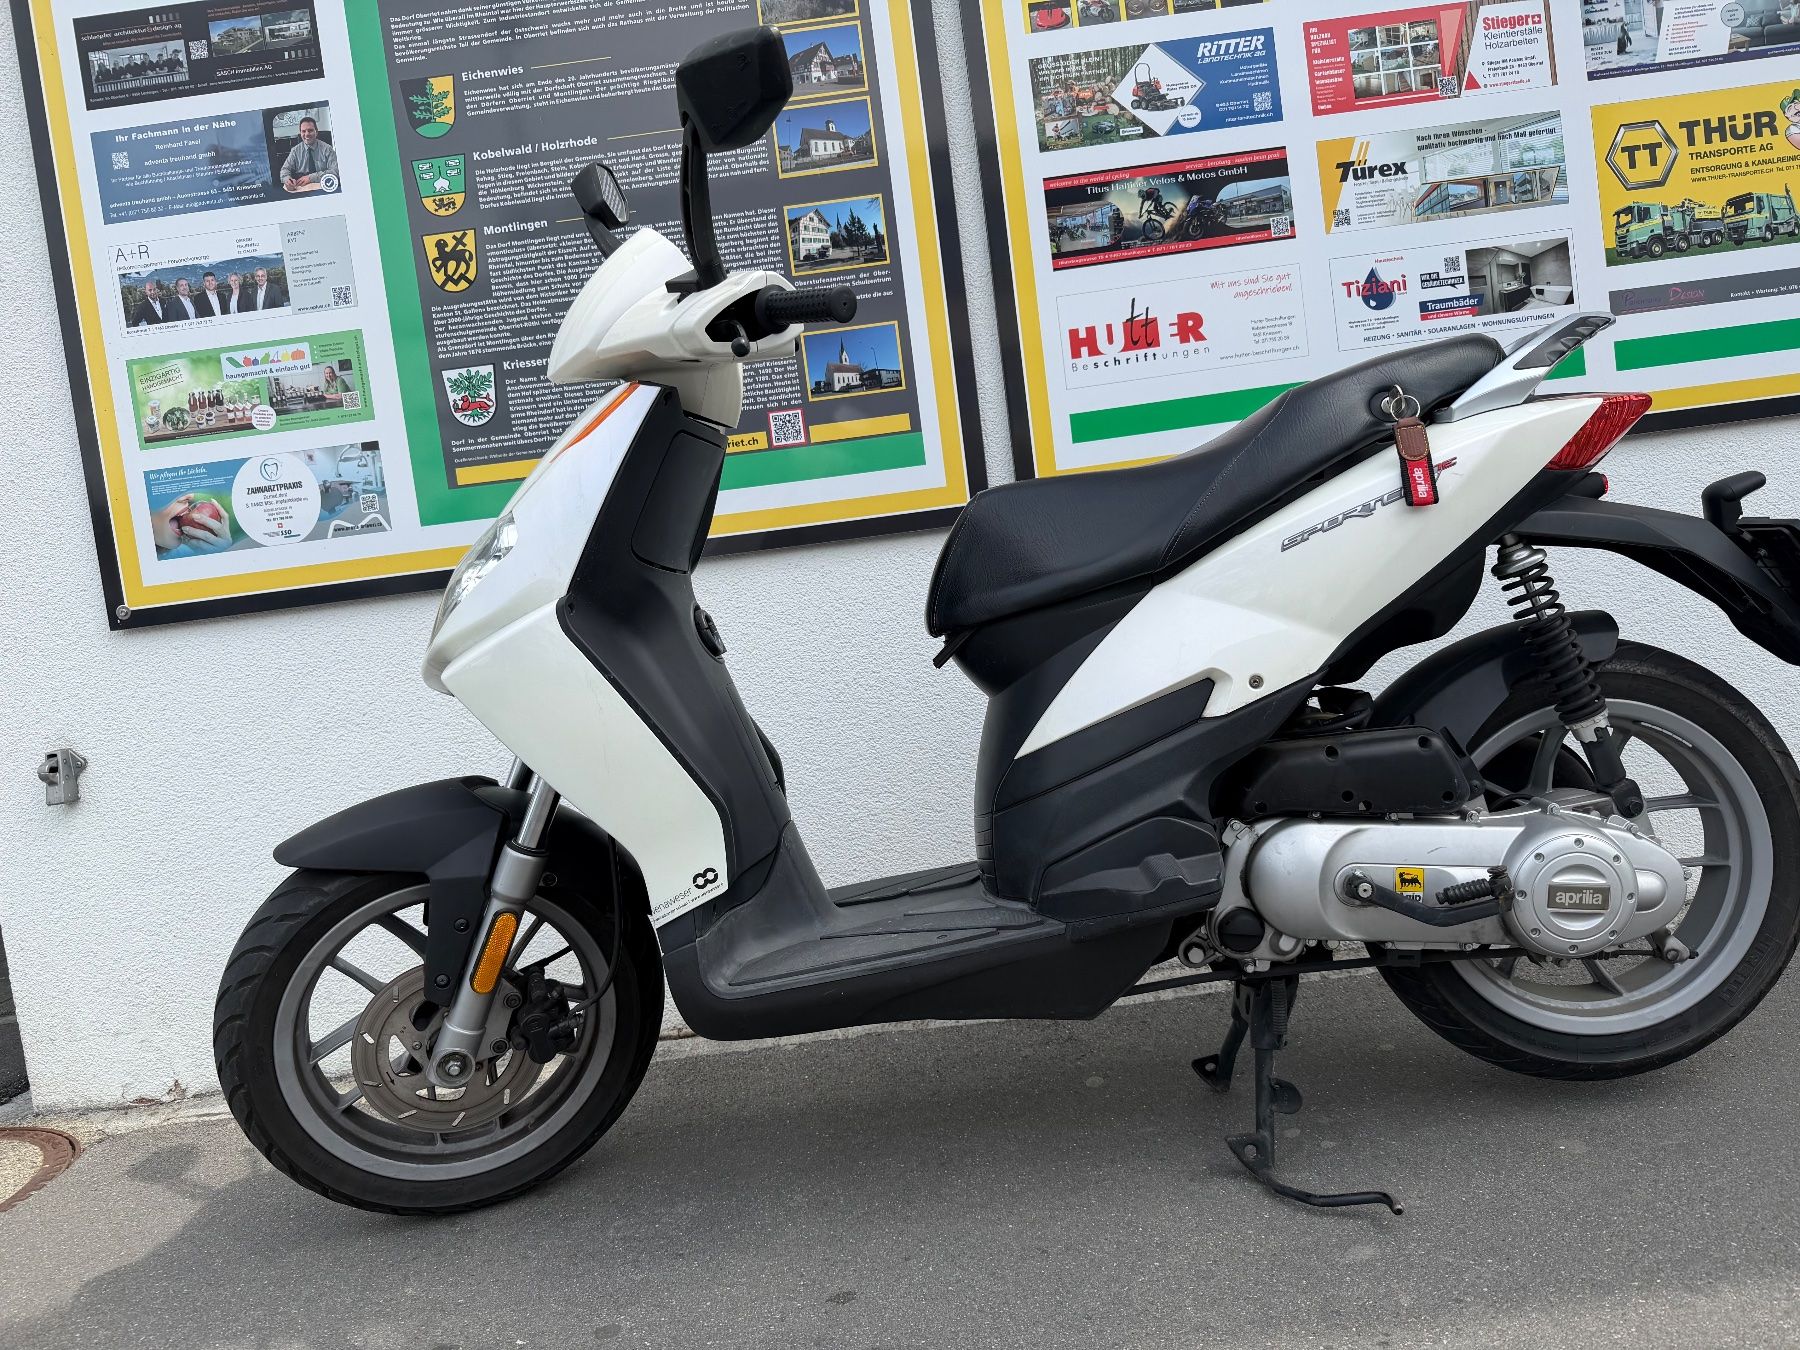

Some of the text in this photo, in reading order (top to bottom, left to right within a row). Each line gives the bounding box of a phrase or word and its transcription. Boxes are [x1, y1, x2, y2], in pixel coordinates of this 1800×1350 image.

[1482, 13, 1530, 31] Stieger
[1483, 25, 1542, 40] Kleintierställe
[1484, 36, 1538, 50] Holzarbeiten
[461, 65, 523, 81] Eichenwies
[115, 120, 236, 142] Ihr Fachmann in der Nähe
[1415, 133, 1432, 142] Nach
[1451, 128, 1482, 137] Wünschen
[1678, 110, 1779, 147] THÜR
[472, 135, 597, 160] Kobelwald / Holzrhode
[1416, 140, 1446, 152] qualitativ
[1484, 134, 1496, 142] und
[1497, 132, 1512, 143] nach
[1528, 126, 1556, 137] gefertigt
[169, 152, 197, 163] treuhand
[1620, 141, 1662, 169] TT
[1688, 142, 1773, 160] TRANSPORTE AG
[1111, 172, 1130, 180] cycling
[1334, 158, 1408, 183] Türex
[1690, 161, 1742, 174] ENTSORGUNG
[1086, 186, 1110, 194] Titus
[1148, 176, 1176, 187] Velos
[1177, 174, 1184, 182] &
[1186, 171, 1216, 180] Motos
[1217, 165, 1247, 176] GmbH
[483, 220, 548, 235] Montlingen
[1209, 272, 1291, 290] Mit uns sind Sie gut
[1341, 273, 1407, 298] Tiziani
[1233, 282, 1292, 299] angeschrieben!
[1426, 297, 1478, 310] Traumbäder
[1426, 312, 1437, 321] und
[1363, 312, 1555, 342] HEIZUNG SANITÄR SOLARANLAGEN WOHNUNGSLÜFTUNGEN
[1071, 346, 1210, 372] Beschriftungen
[139, 367, 181, 385] EINZIGARTIG
[225, 368, 268, 382] hausgemacht
[274, 364, 298, 372] einfach
[299, 363, 310, 371] gut
[159, 470, 178, 480] pflegen
[1413, 467, 1426, 498] aprilia
[246, 480, 303, 495] ZAHNARZTPRAXIS
[1555, 889, 1602, 905] aprilia
